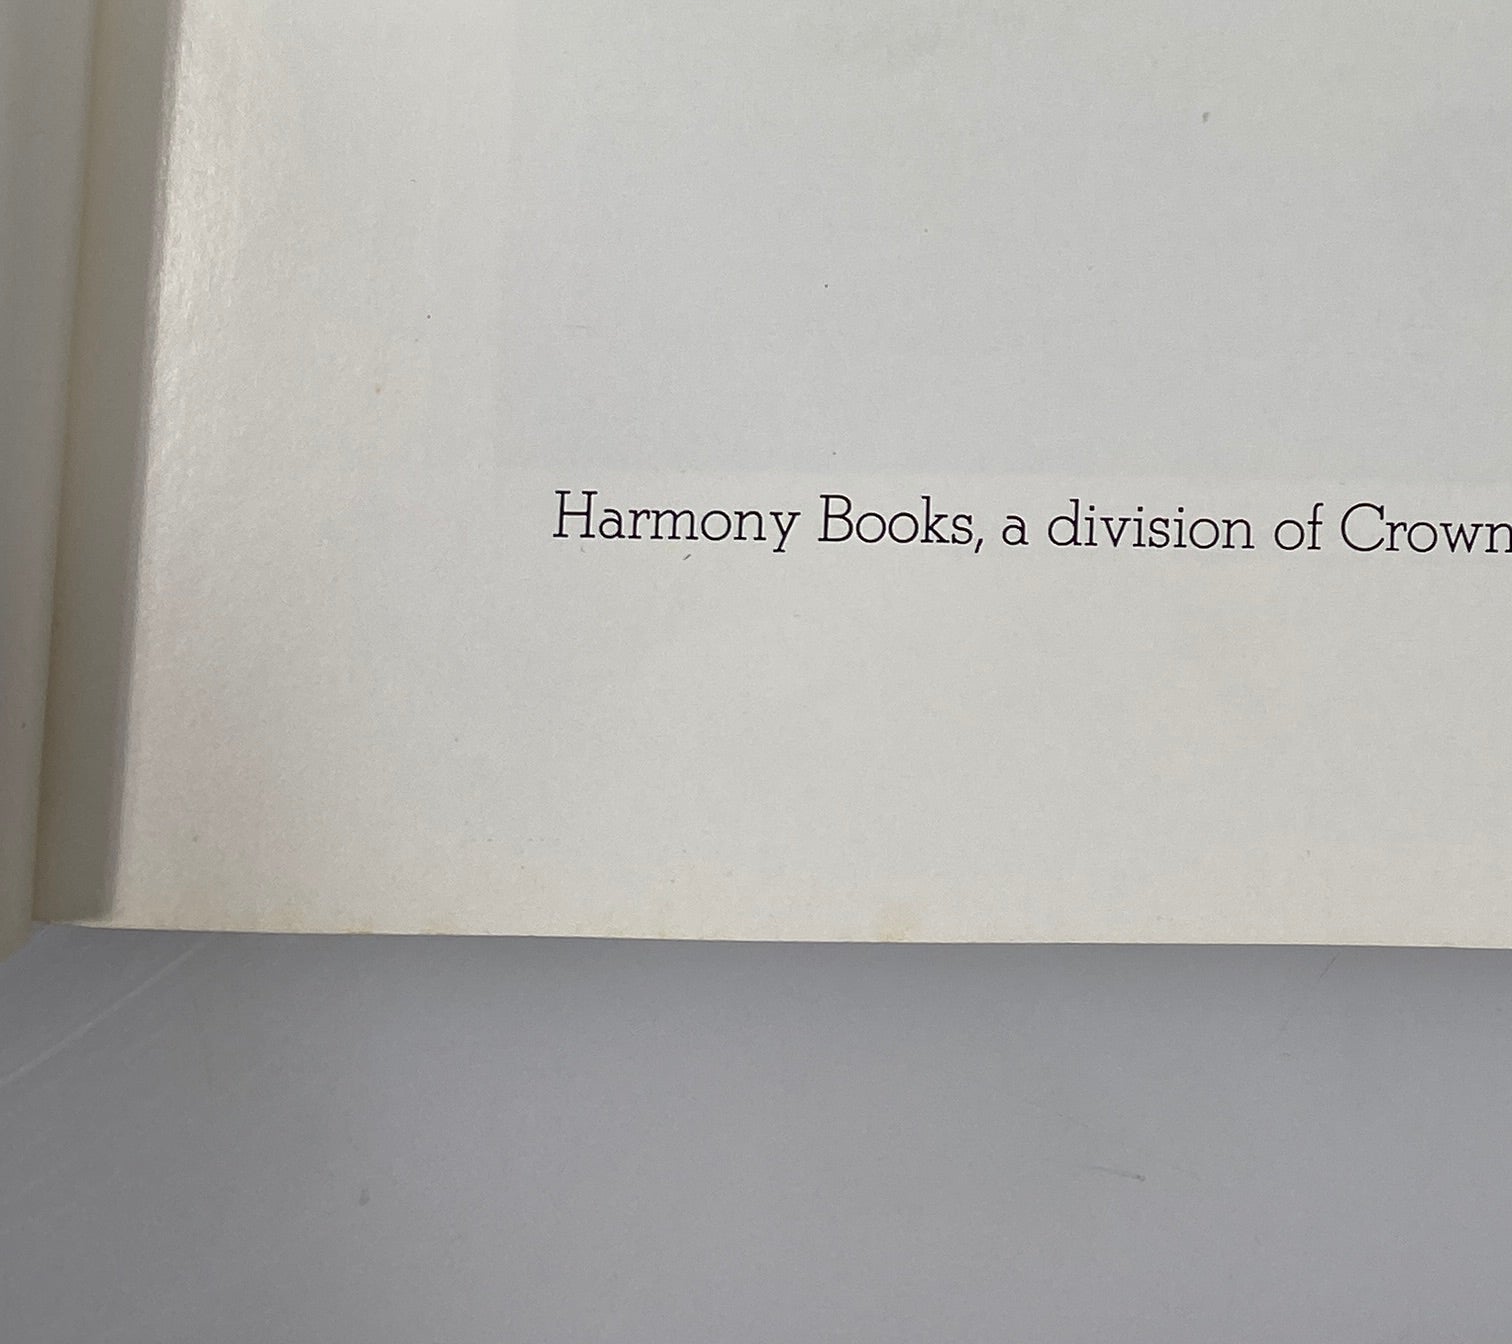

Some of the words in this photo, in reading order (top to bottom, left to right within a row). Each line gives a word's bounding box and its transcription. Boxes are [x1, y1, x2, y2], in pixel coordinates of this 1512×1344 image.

[553, 490, 801, 555] Harmony
[818, 495, 983, 555] Books,
[1002, 516, 1029, 546] a
[1048, 499, 1255, 550] division
[1274, 503, 1324, 551] of
